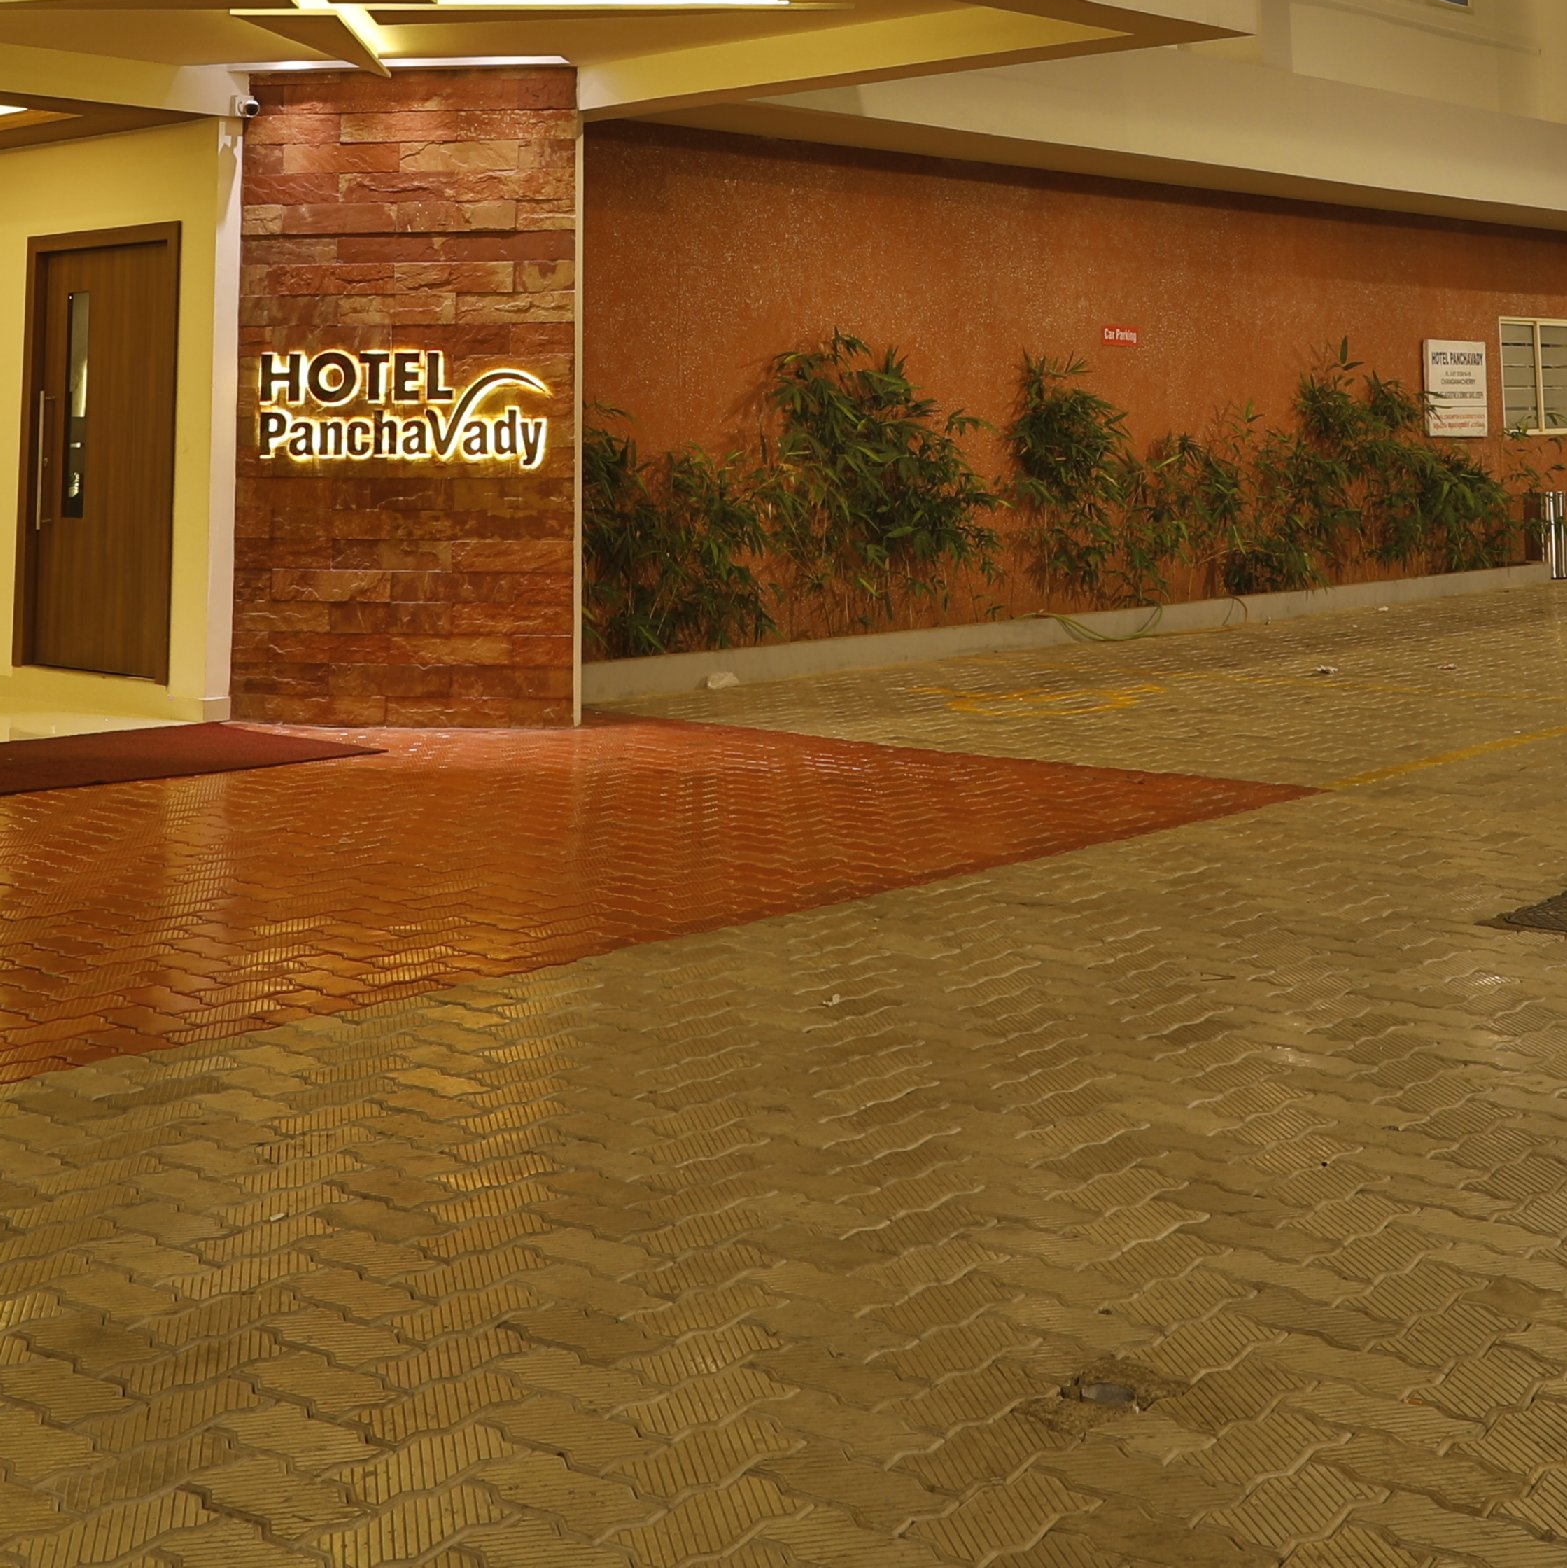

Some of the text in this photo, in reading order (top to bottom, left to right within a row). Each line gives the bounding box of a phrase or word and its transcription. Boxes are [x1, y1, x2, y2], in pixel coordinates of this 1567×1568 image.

[1104, 328, 1137, 343] Car Parking
[1431, 352, 1449, 366] HOTEL
[259, 350, 454, 403] HOTEL
